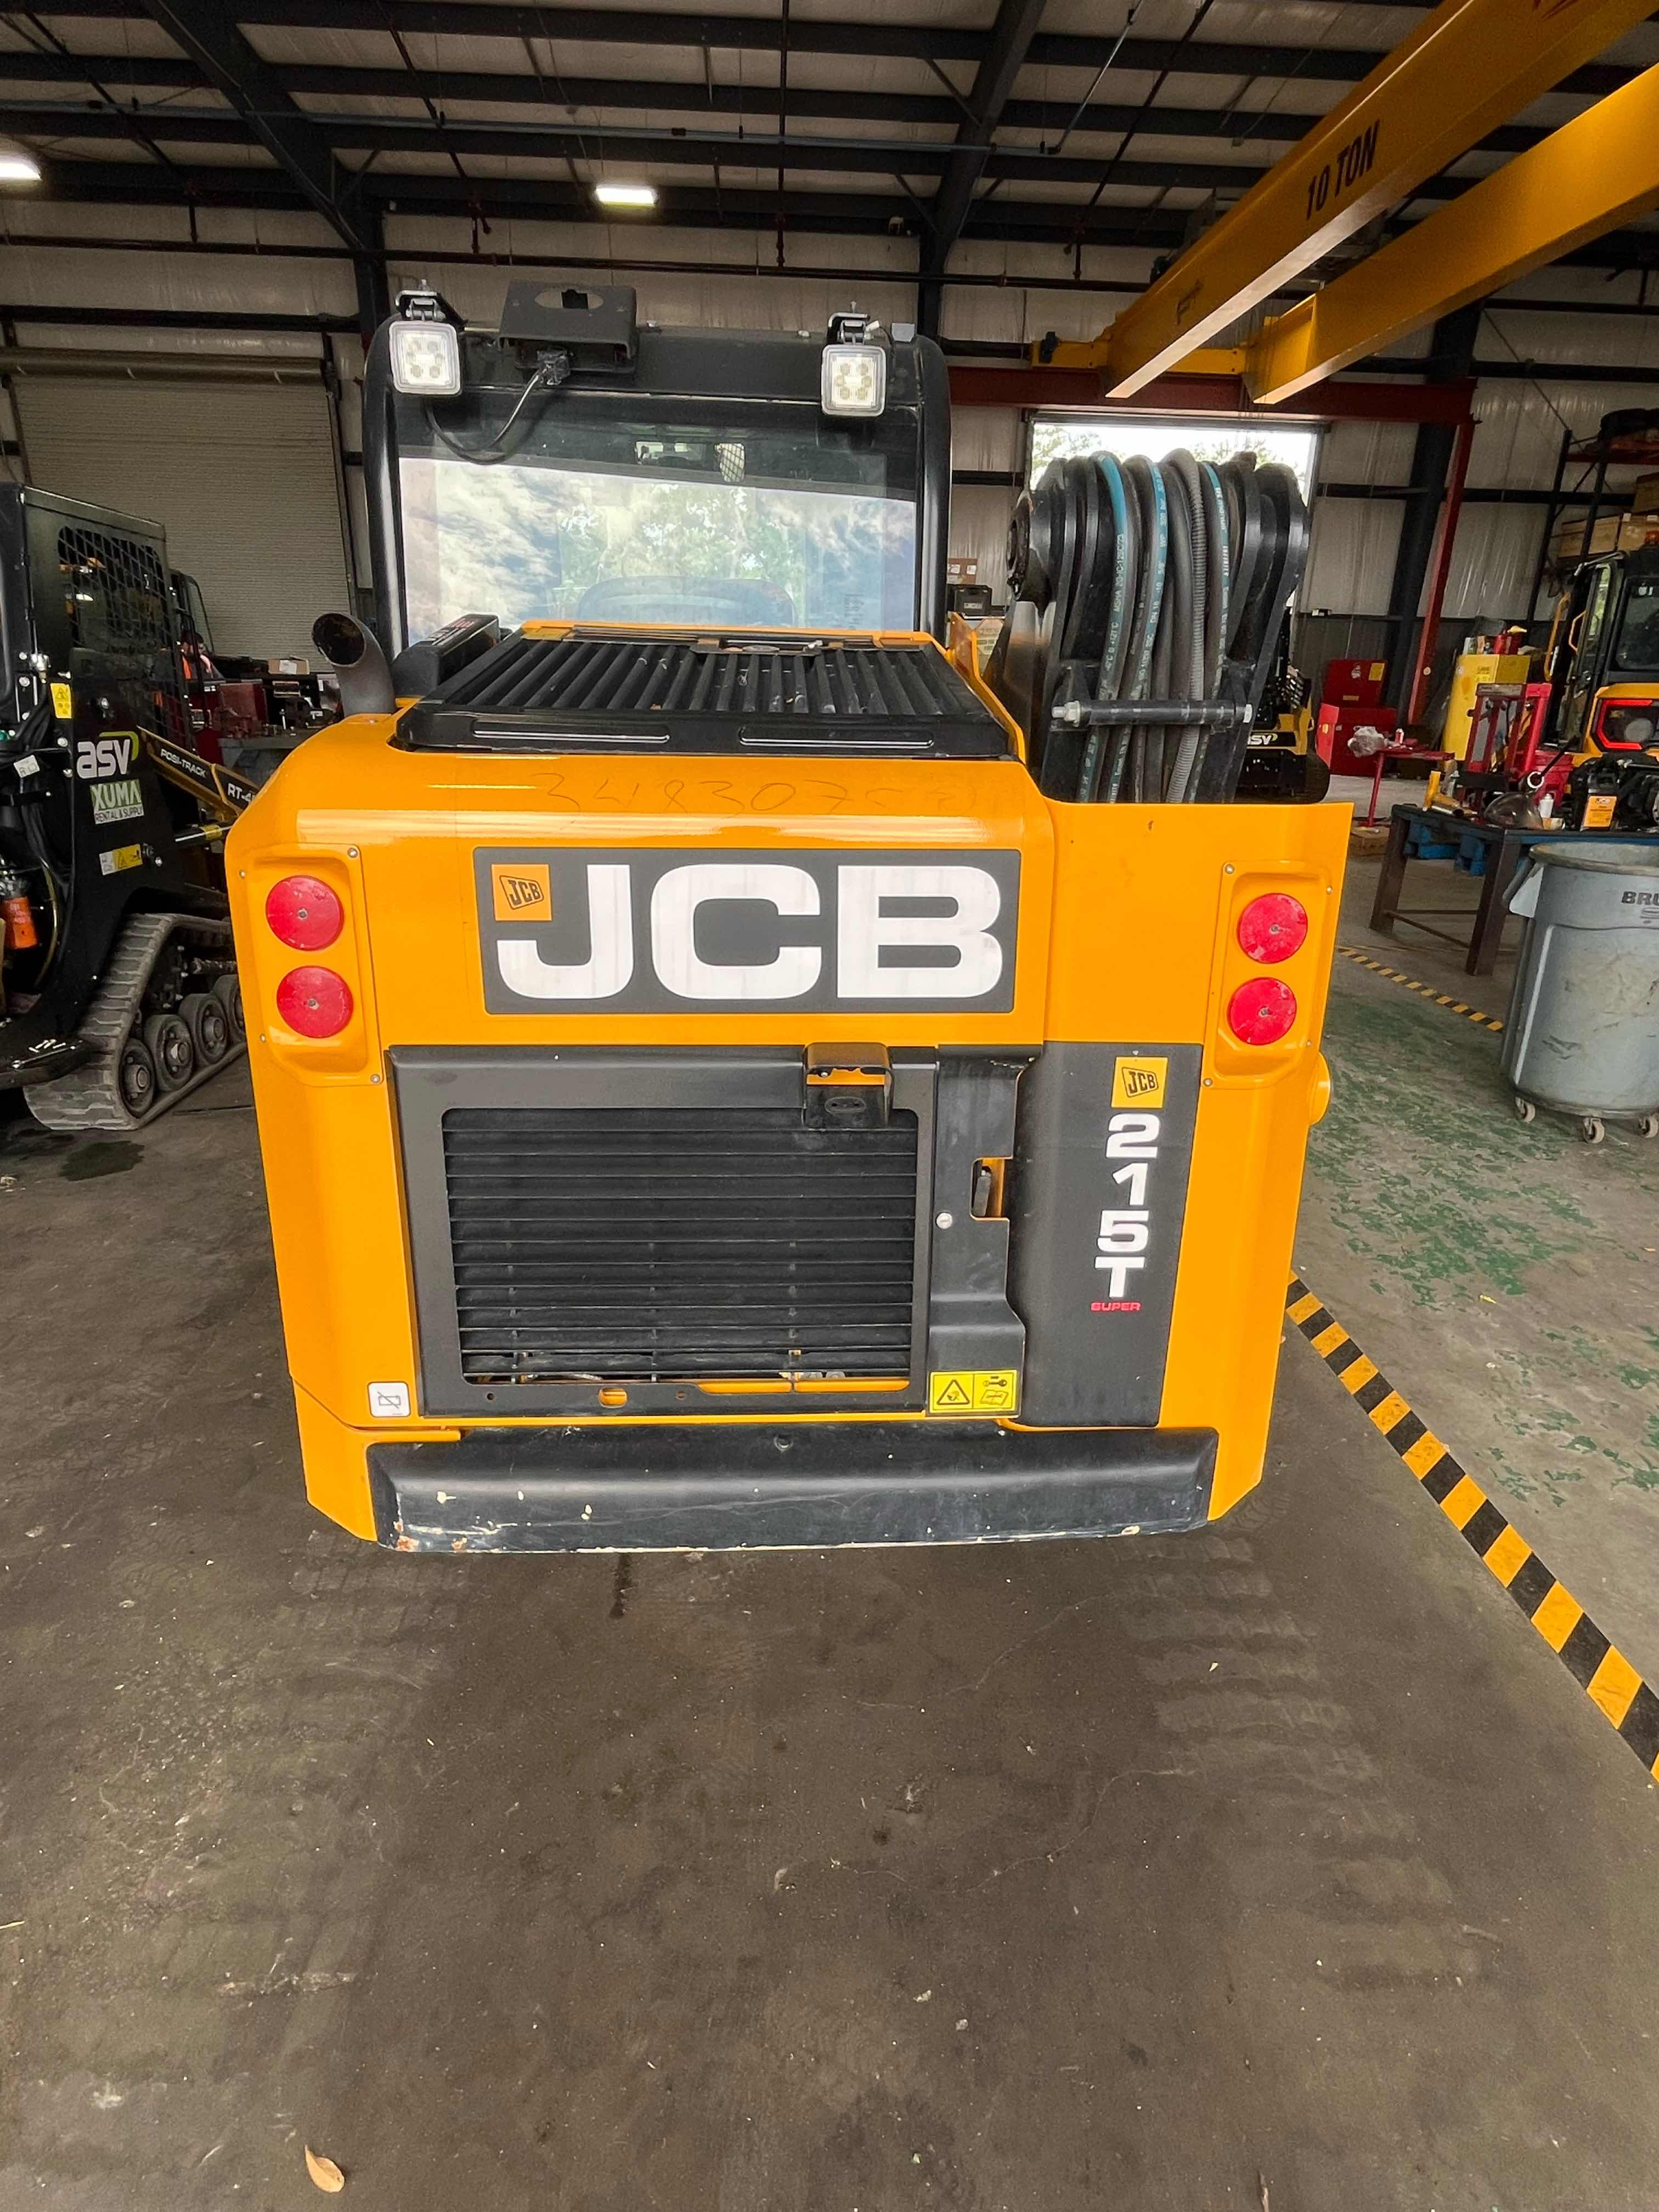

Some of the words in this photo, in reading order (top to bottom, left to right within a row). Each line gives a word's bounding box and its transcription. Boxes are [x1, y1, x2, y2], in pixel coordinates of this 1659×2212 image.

[1306, 165, 1330, 221] 10
[1334, 119, 1381, 198] TON
[160, 748, 207, 778] POSI-TRACK
[91, 780, 142, 811] XUMA
[228, 782, 255, 803] RT-4
[507, 879, 541, 906] JCB
[496, 864, 1003, 999] JCB
[1127, 1071, 1156, 1094] JCB
[1091, 1301, 1141, 1312] SUPER
